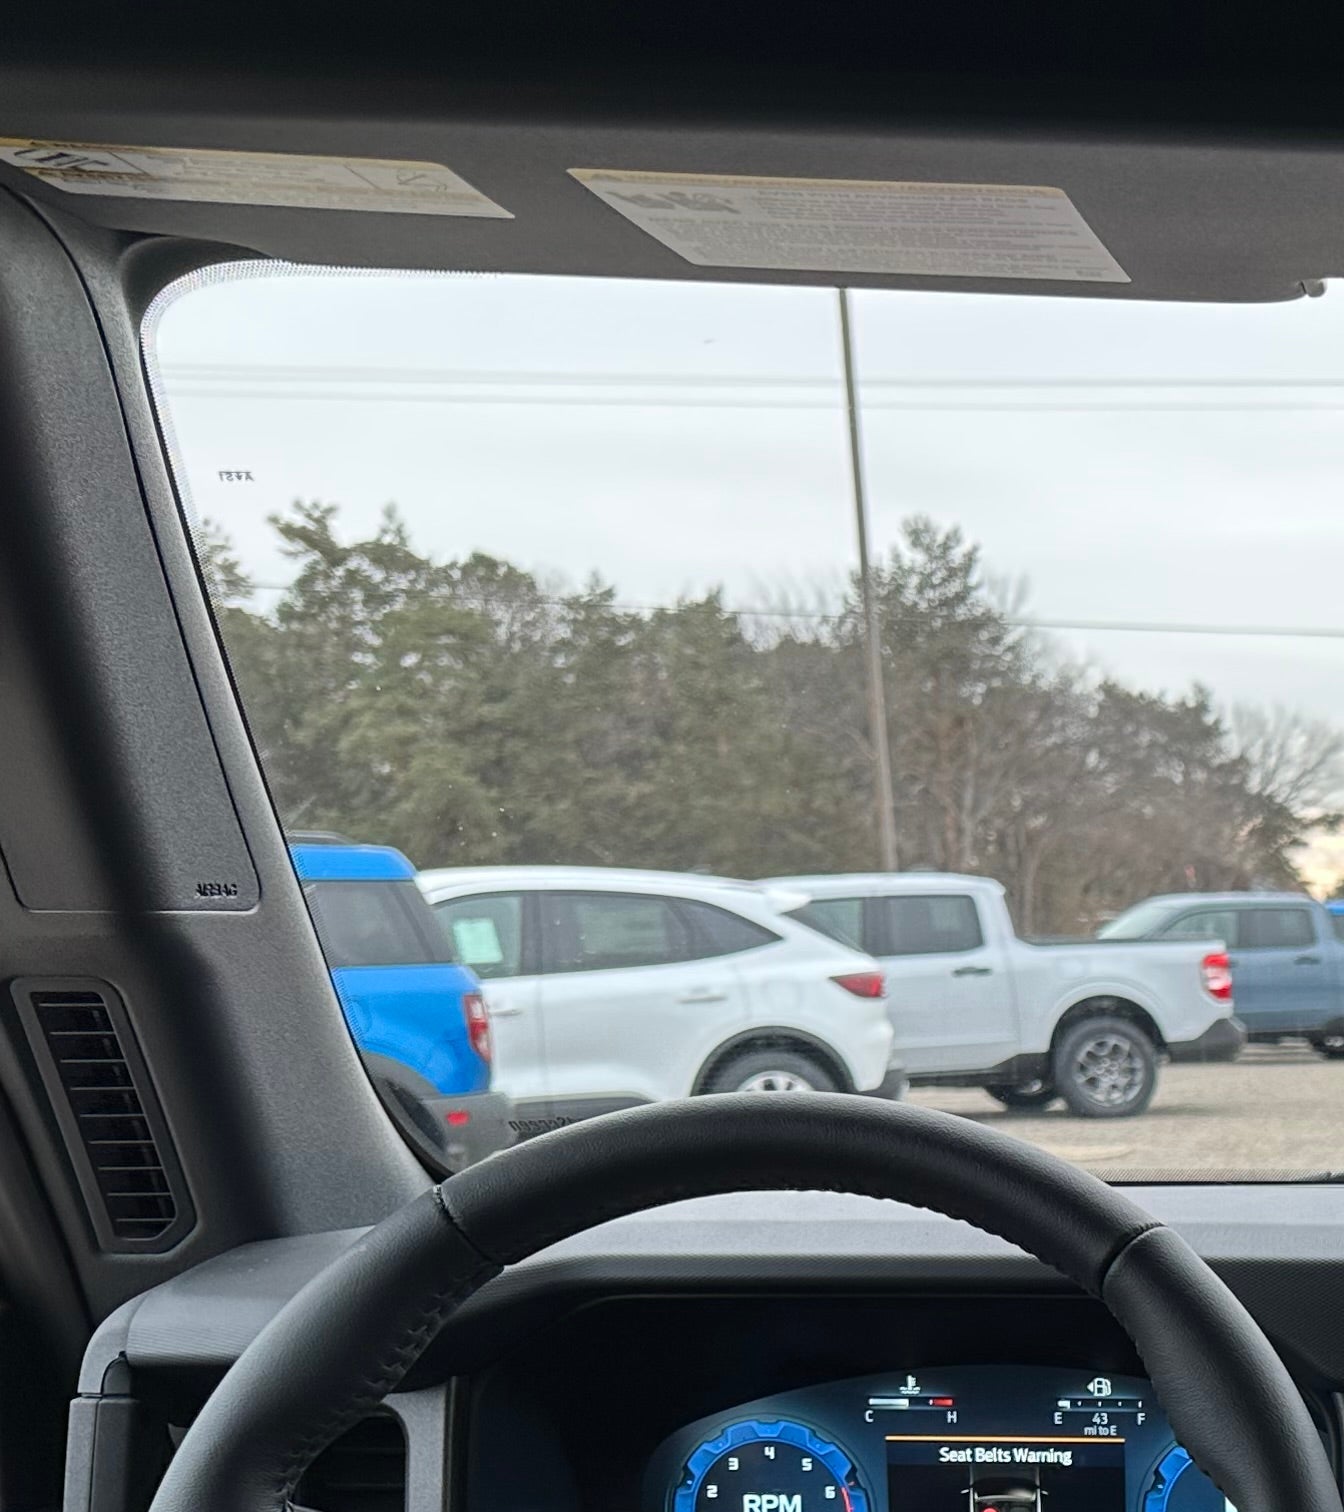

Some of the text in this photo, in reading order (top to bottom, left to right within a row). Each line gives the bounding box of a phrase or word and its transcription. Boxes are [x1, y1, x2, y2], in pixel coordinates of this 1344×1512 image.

[864, 1411, 874, 1422] C
[947, 1411, 957, 1424] H
[1054, 1413, 1062, 1424] E
[1092, 1413, 1108, 1425] 43
[1137, 1413, 1146, 1425] F
[1098, 1426, 1109, 1435] to
[1110, 1427, 1117, 1435] E
[764, 1447, 775, 1460] 4
[939, 1448, 1072, 1465] Seat Belts Warning
[728, 1457, 739, 1470] 3
[802, 1458, 812, 1471] 5
[706, 1485, 718, 1498] 2
[824, 1486, 835, 1499] 6
